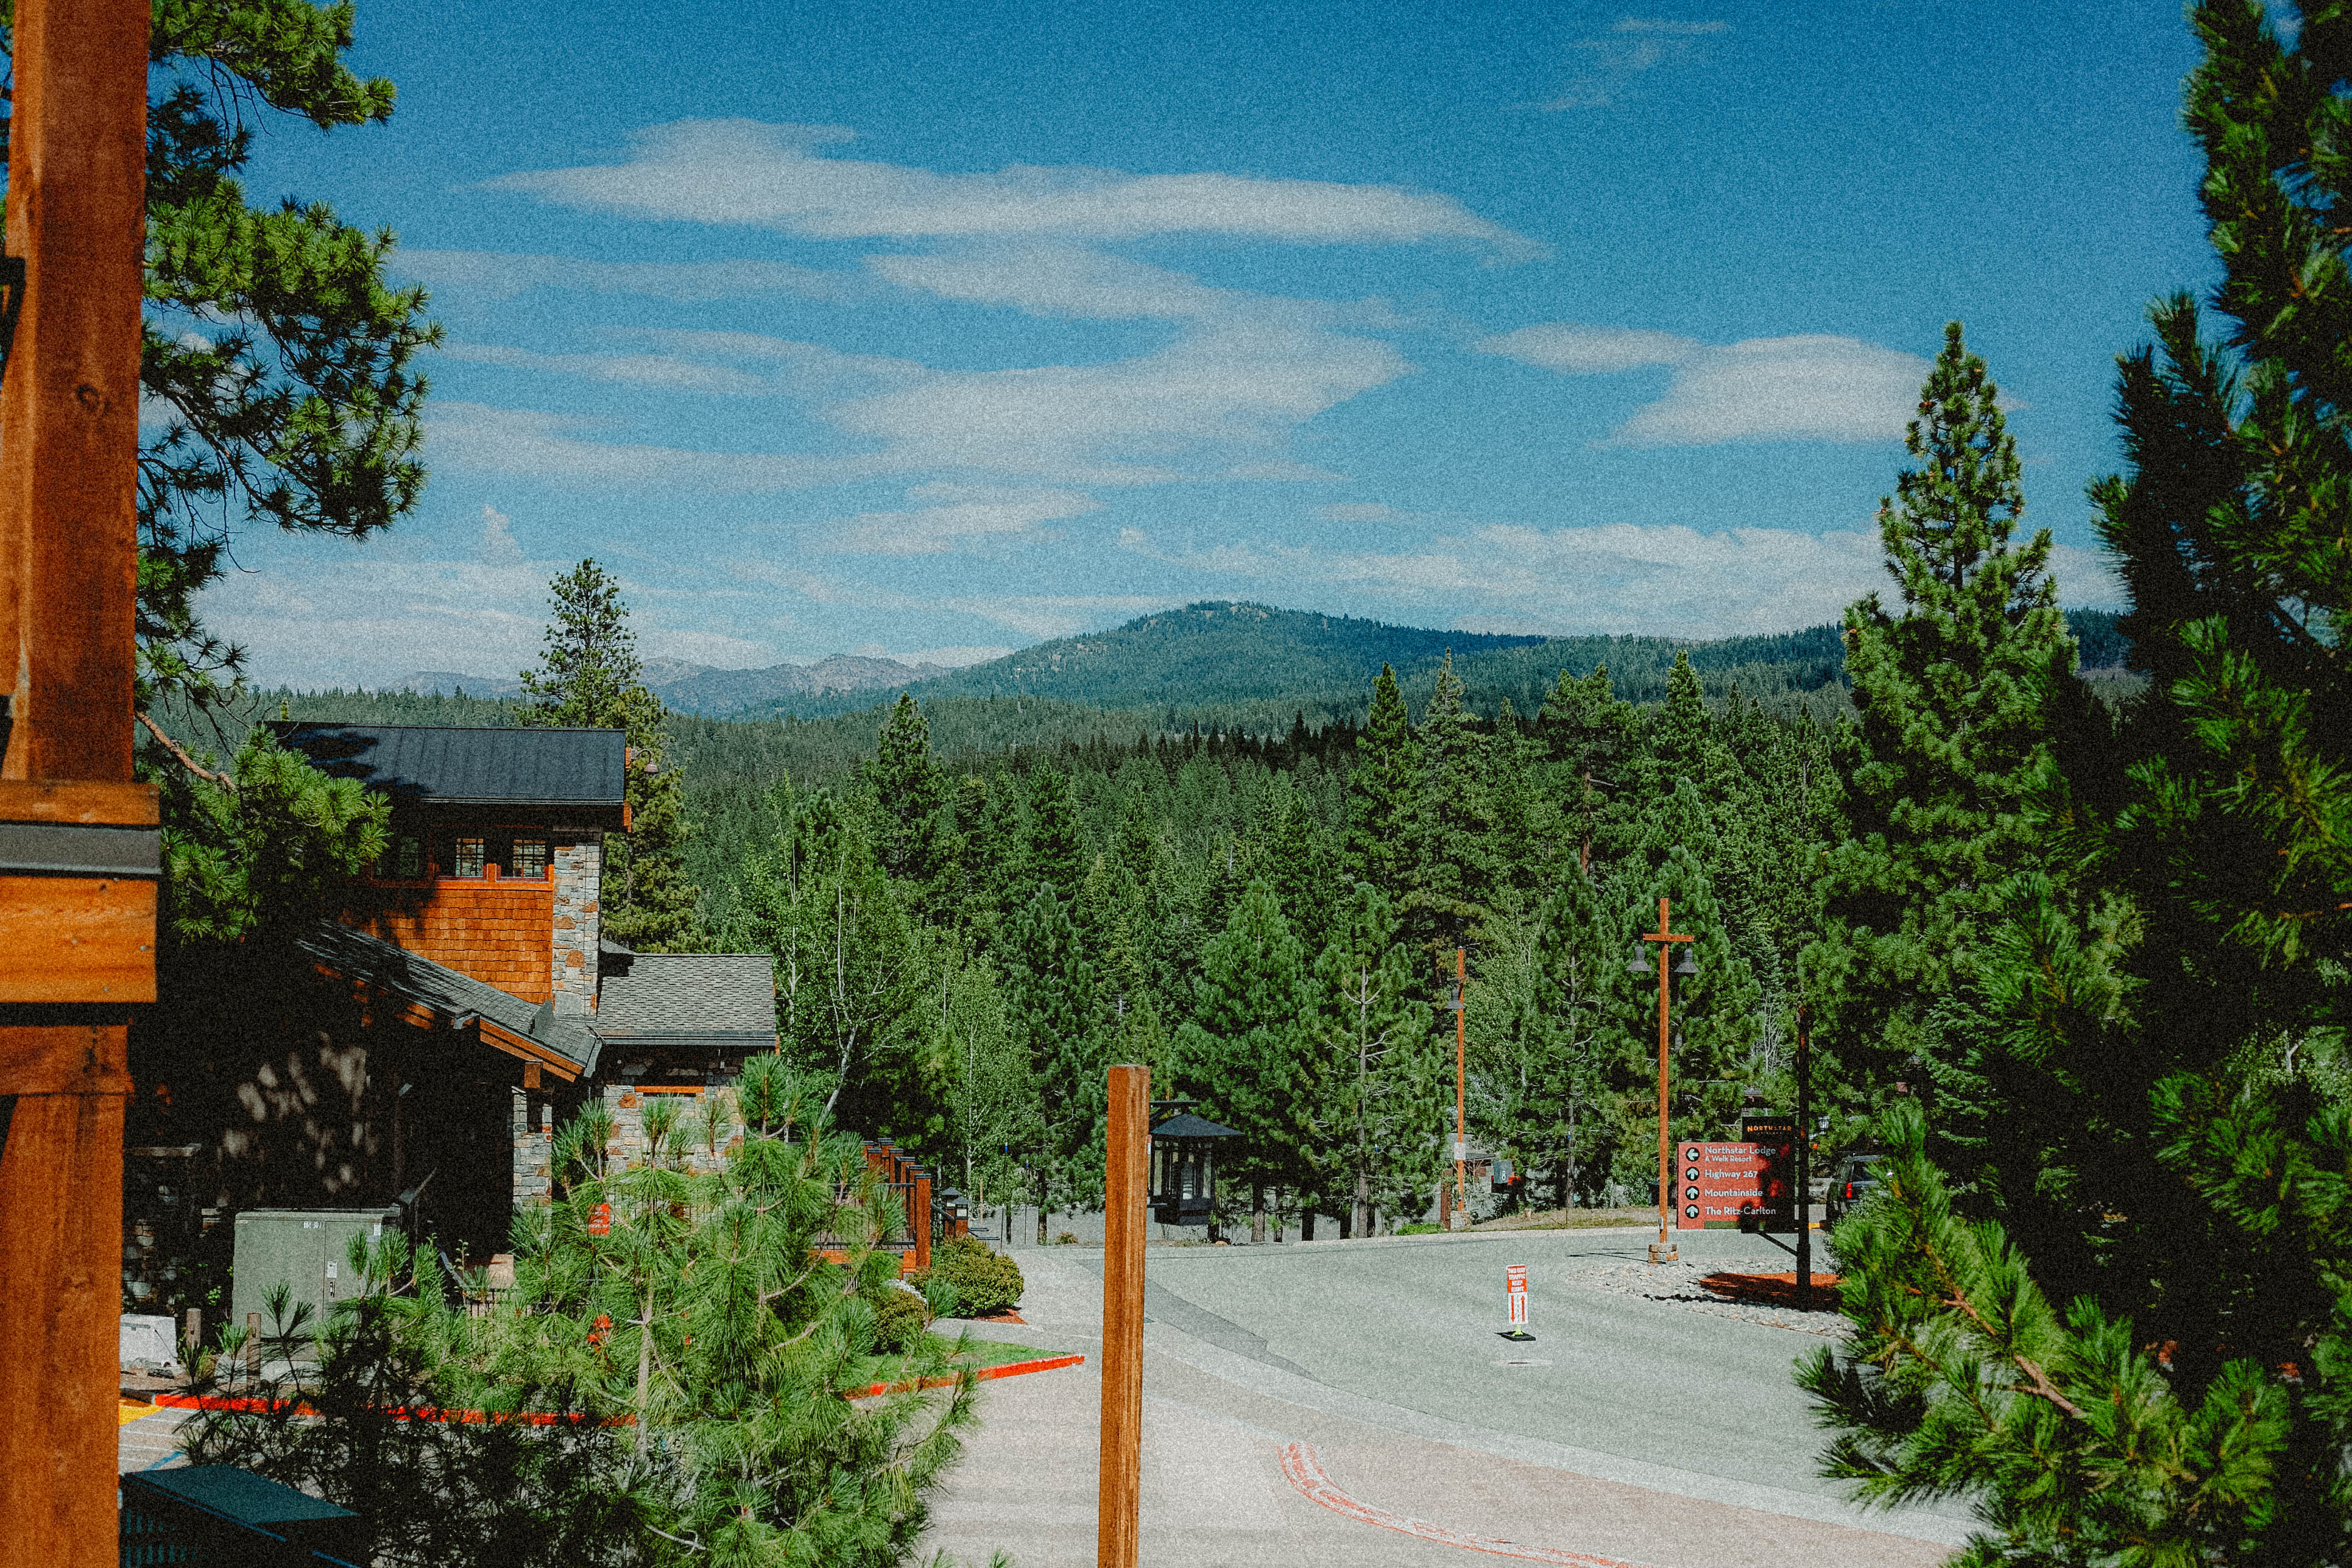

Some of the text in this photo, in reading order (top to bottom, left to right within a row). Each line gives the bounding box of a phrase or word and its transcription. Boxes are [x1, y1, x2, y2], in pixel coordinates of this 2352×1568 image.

[1705, 1145, 1776, 1156] Northstar Lodge
[1502, 1170, 1506, 1181] 8
[1704, 1170, 1758, 1180] Highway 267
[1704, 1188, 1763, 1197] Mountainside
[1705, 1206, 1776, 1215] The Ritz-Carlton
